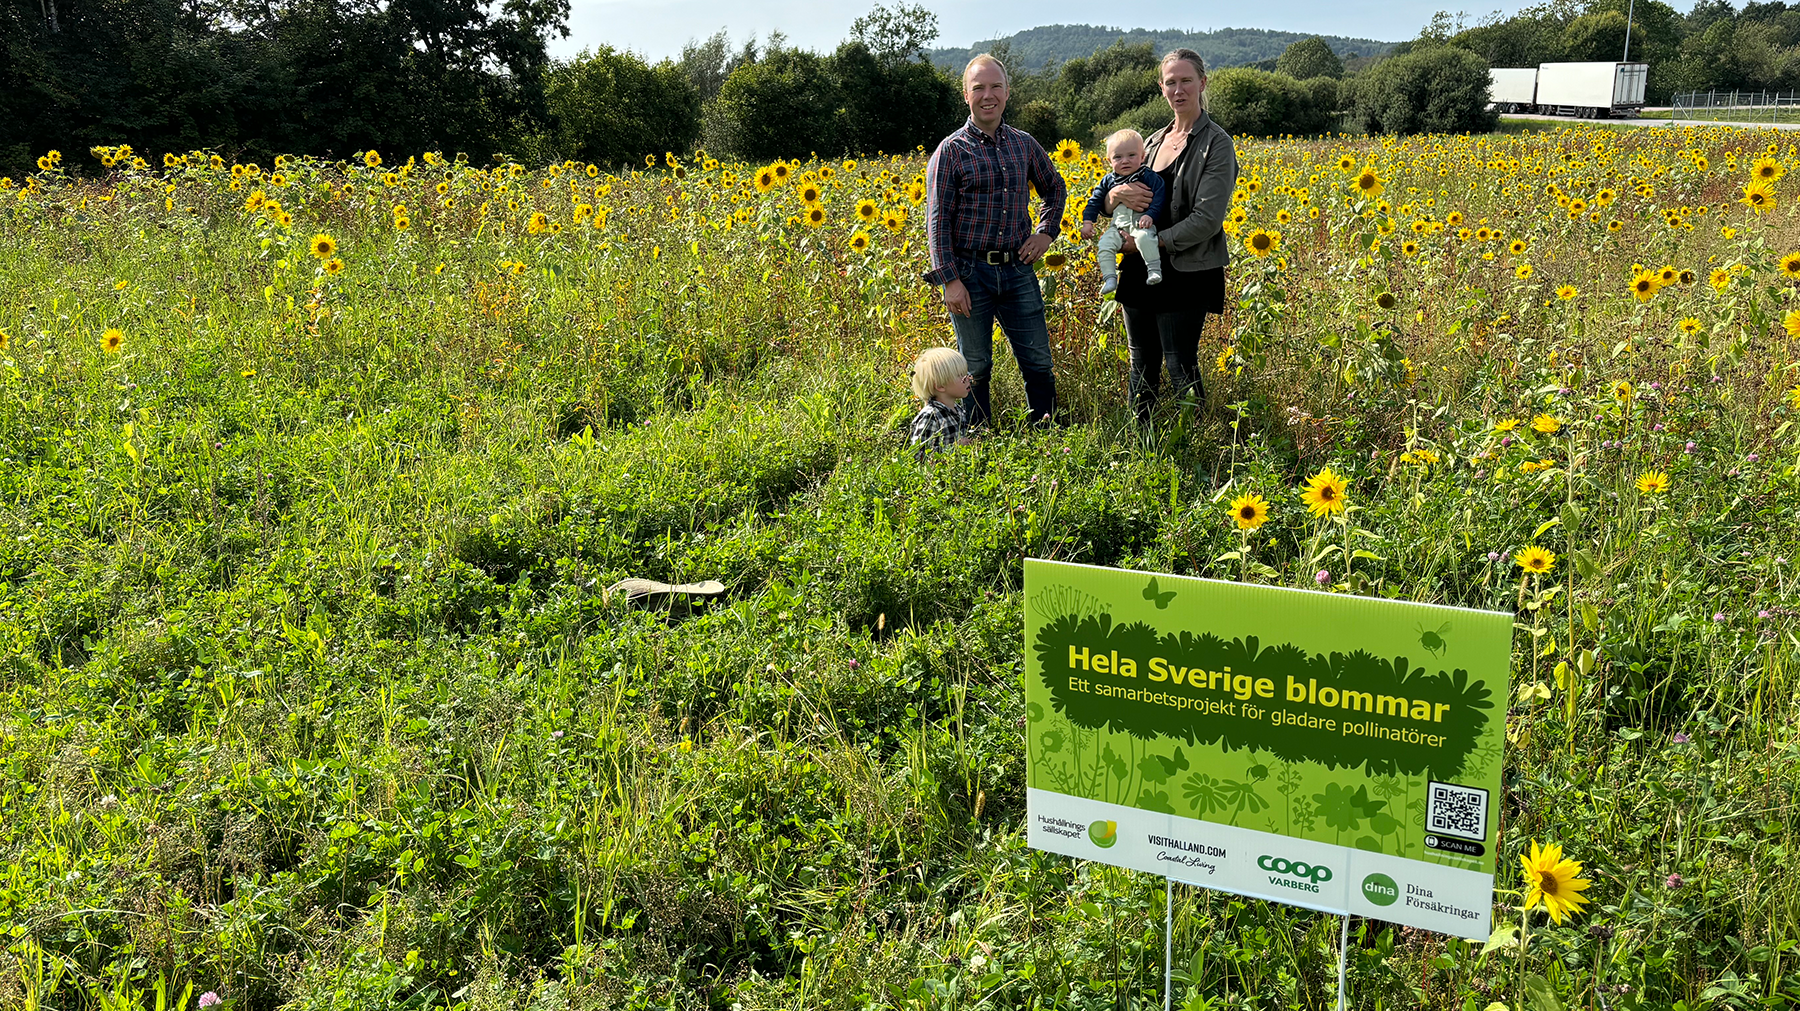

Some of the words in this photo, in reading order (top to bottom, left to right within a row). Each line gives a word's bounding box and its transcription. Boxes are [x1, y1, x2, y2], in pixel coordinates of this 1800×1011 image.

[1069, 645, 1137, 678] Hela
[1148, 656, 1275, 700] Sverige
[1286, 674, 1450, 722] blommar
[1069, 677, 1090, 693] Ett
[1095, 683, 1237, 717] samarbetsprojekt
[1242, 703, 1266, 720] för
[1271, 709, 1337, 732] gladare
[1343, 721, 1447, 747] pollinatörer
[1038, 814, 1086, 832] Hushållnings
[1043, 825, 1081, 839] sällskapet
[1148, 834, 1227, 859] VISITHALLAND.COM
[1440, 840, 1463, 850] SCAN
[1464, 845, 1477, 853] ME
[1156, 850, 1188, 864] Coastal
[1185, 857, 1216, 875] Living
[1257, 854, 1333, 884] coop
[1268, 875, 1320, 894] VARBERG
[1365, 881, 1396, 897] dina
[1406, 883, 1433, 898] Dina
[1405, 895, 1481, 920] Försäkringar
